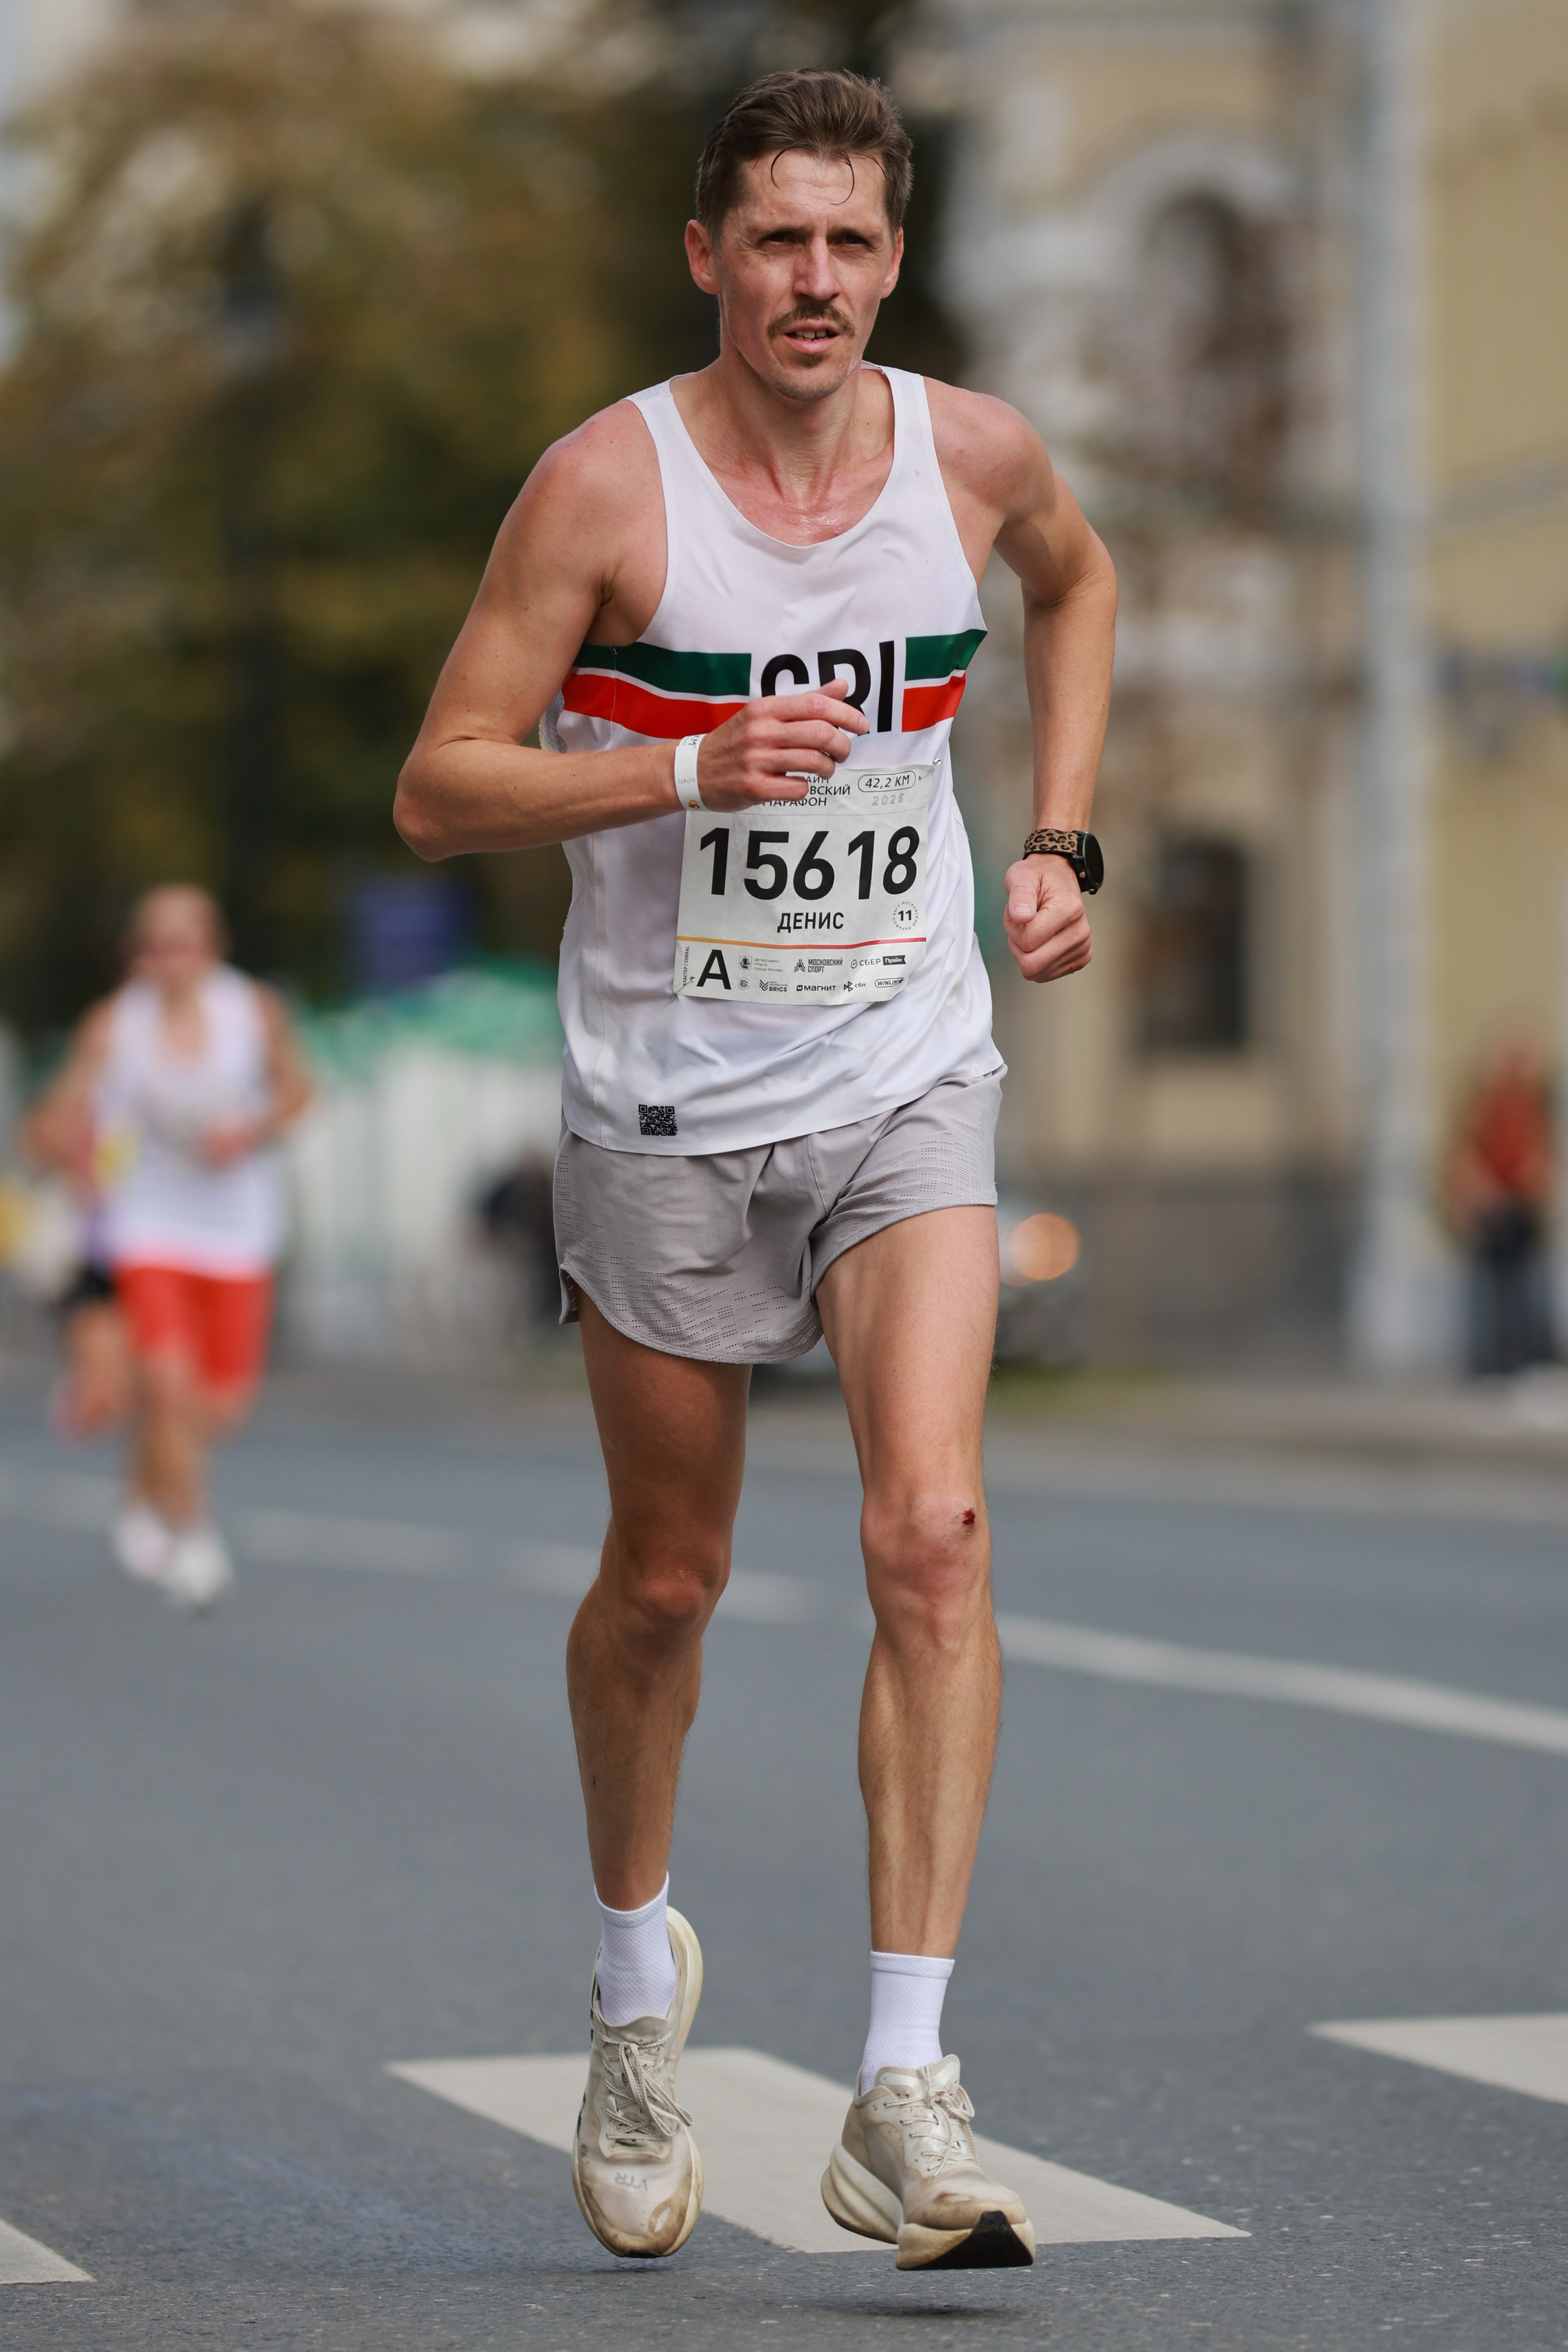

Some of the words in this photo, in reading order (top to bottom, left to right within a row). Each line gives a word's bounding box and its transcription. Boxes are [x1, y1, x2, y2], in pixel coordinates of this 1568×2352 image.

[865, 777, 891, 789] 42,2
[810, 784, 850, 795] ВСКИЙ
[872, 793, 904, 806] 2026
[700, 826, 920, 900] 15618
[898, 910, 912, 921] 11
[777, 911, 845, 933] ДЕНИС
[808, 957, 843, 966] МОСКОВСКИЙ
[859, 958, 881, 967] СБЕР
